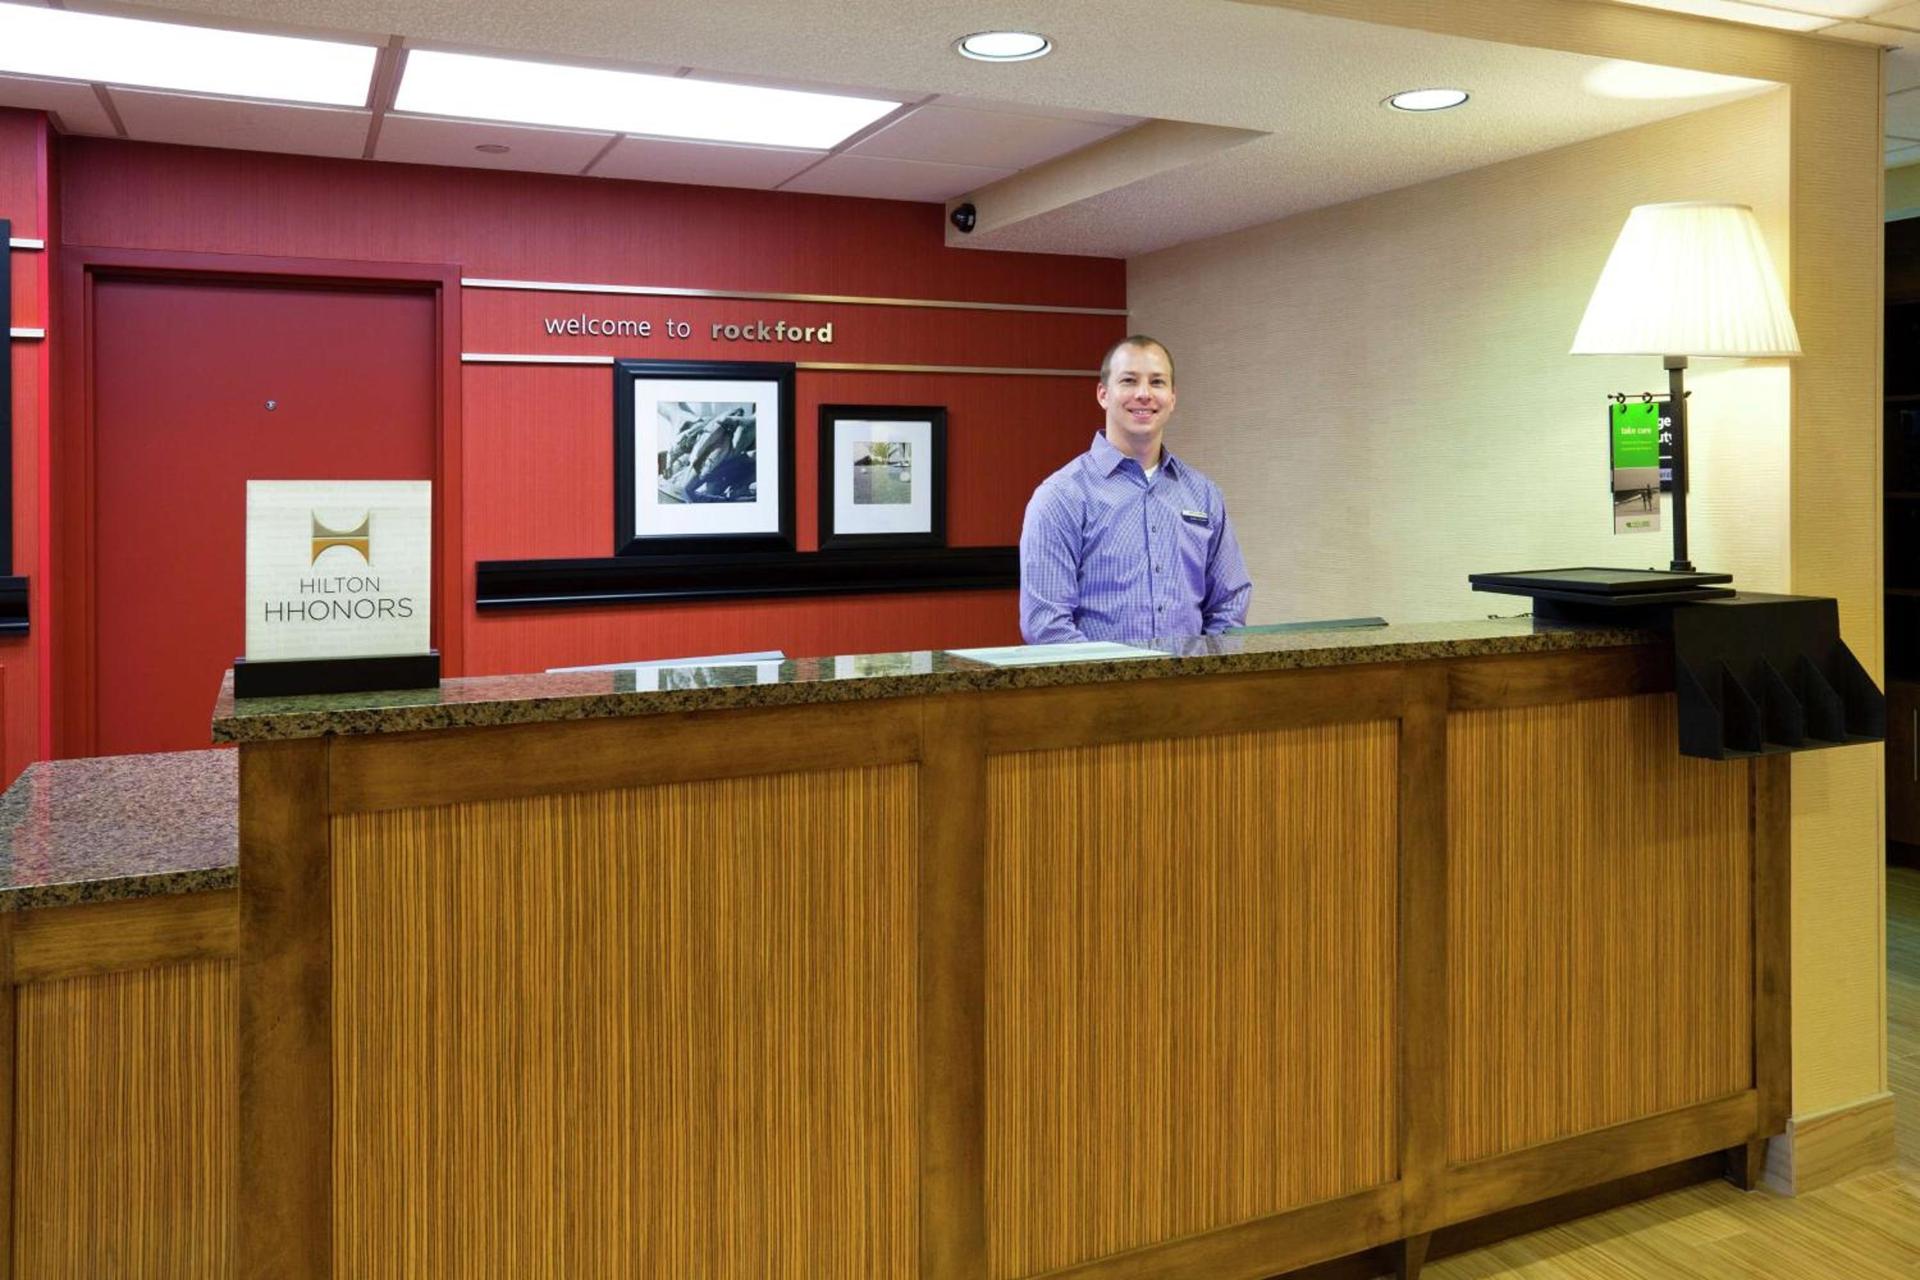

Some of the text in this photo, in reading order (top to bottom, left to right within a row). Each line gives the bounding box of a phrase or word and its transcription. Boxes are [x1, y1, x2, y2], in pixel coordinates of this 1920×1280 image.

[544, 313, 833, 343] welcome to rockford
[300, 576, 380, 594] HILTON
[265, 597, 413, 622] HHONORS
